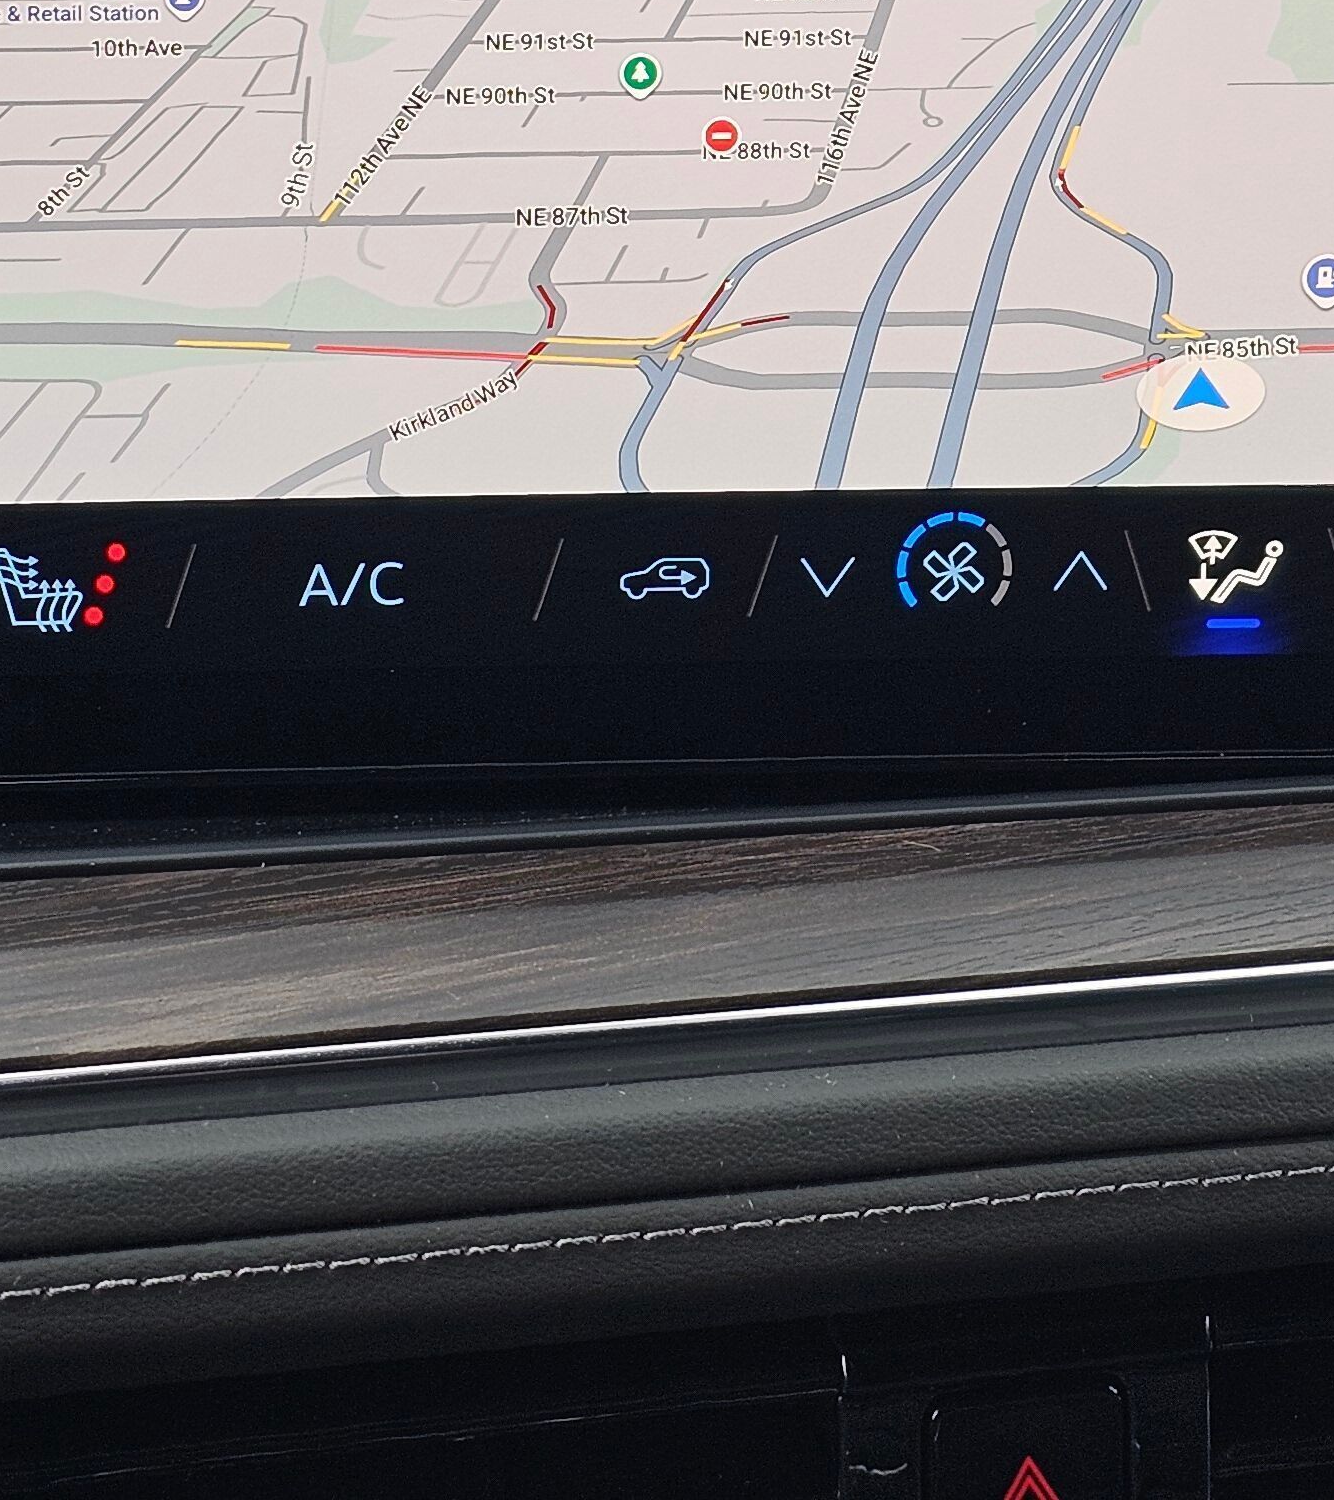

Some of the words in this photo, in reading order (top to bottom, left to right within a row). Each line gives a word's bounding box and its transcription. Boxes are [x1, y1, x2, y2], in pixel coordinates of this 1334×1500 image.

[8, 6, 21, 22] &
[28, 6, 82, 21] Retail
[90, 5, 158, 21] Station
[852, 49, 878, 82] NE
[839, 85, 866, 124] Ave
[293, 143, 313, 169] St
[738, 143, 782, 159] 88th
[789, 143, 810, 158] St
[818, 126, 851, 184] 116th
[37, 187, 68, 216] 8th
[66, 167, 90, 191] St
[281, 175, 307, 206] 9th
[517, 210, 547, 226] NE
[553, 209, 600, 225] 87th
[606, 209, 628, 224] St
[1222, 341, 1269, 357] 85th
[1275, 338, 1298, 354] St
[389, 393, 475, 441] Kirkland
[475, 371, 518, 405] Way
[300, 562, 405, 607] A/C
